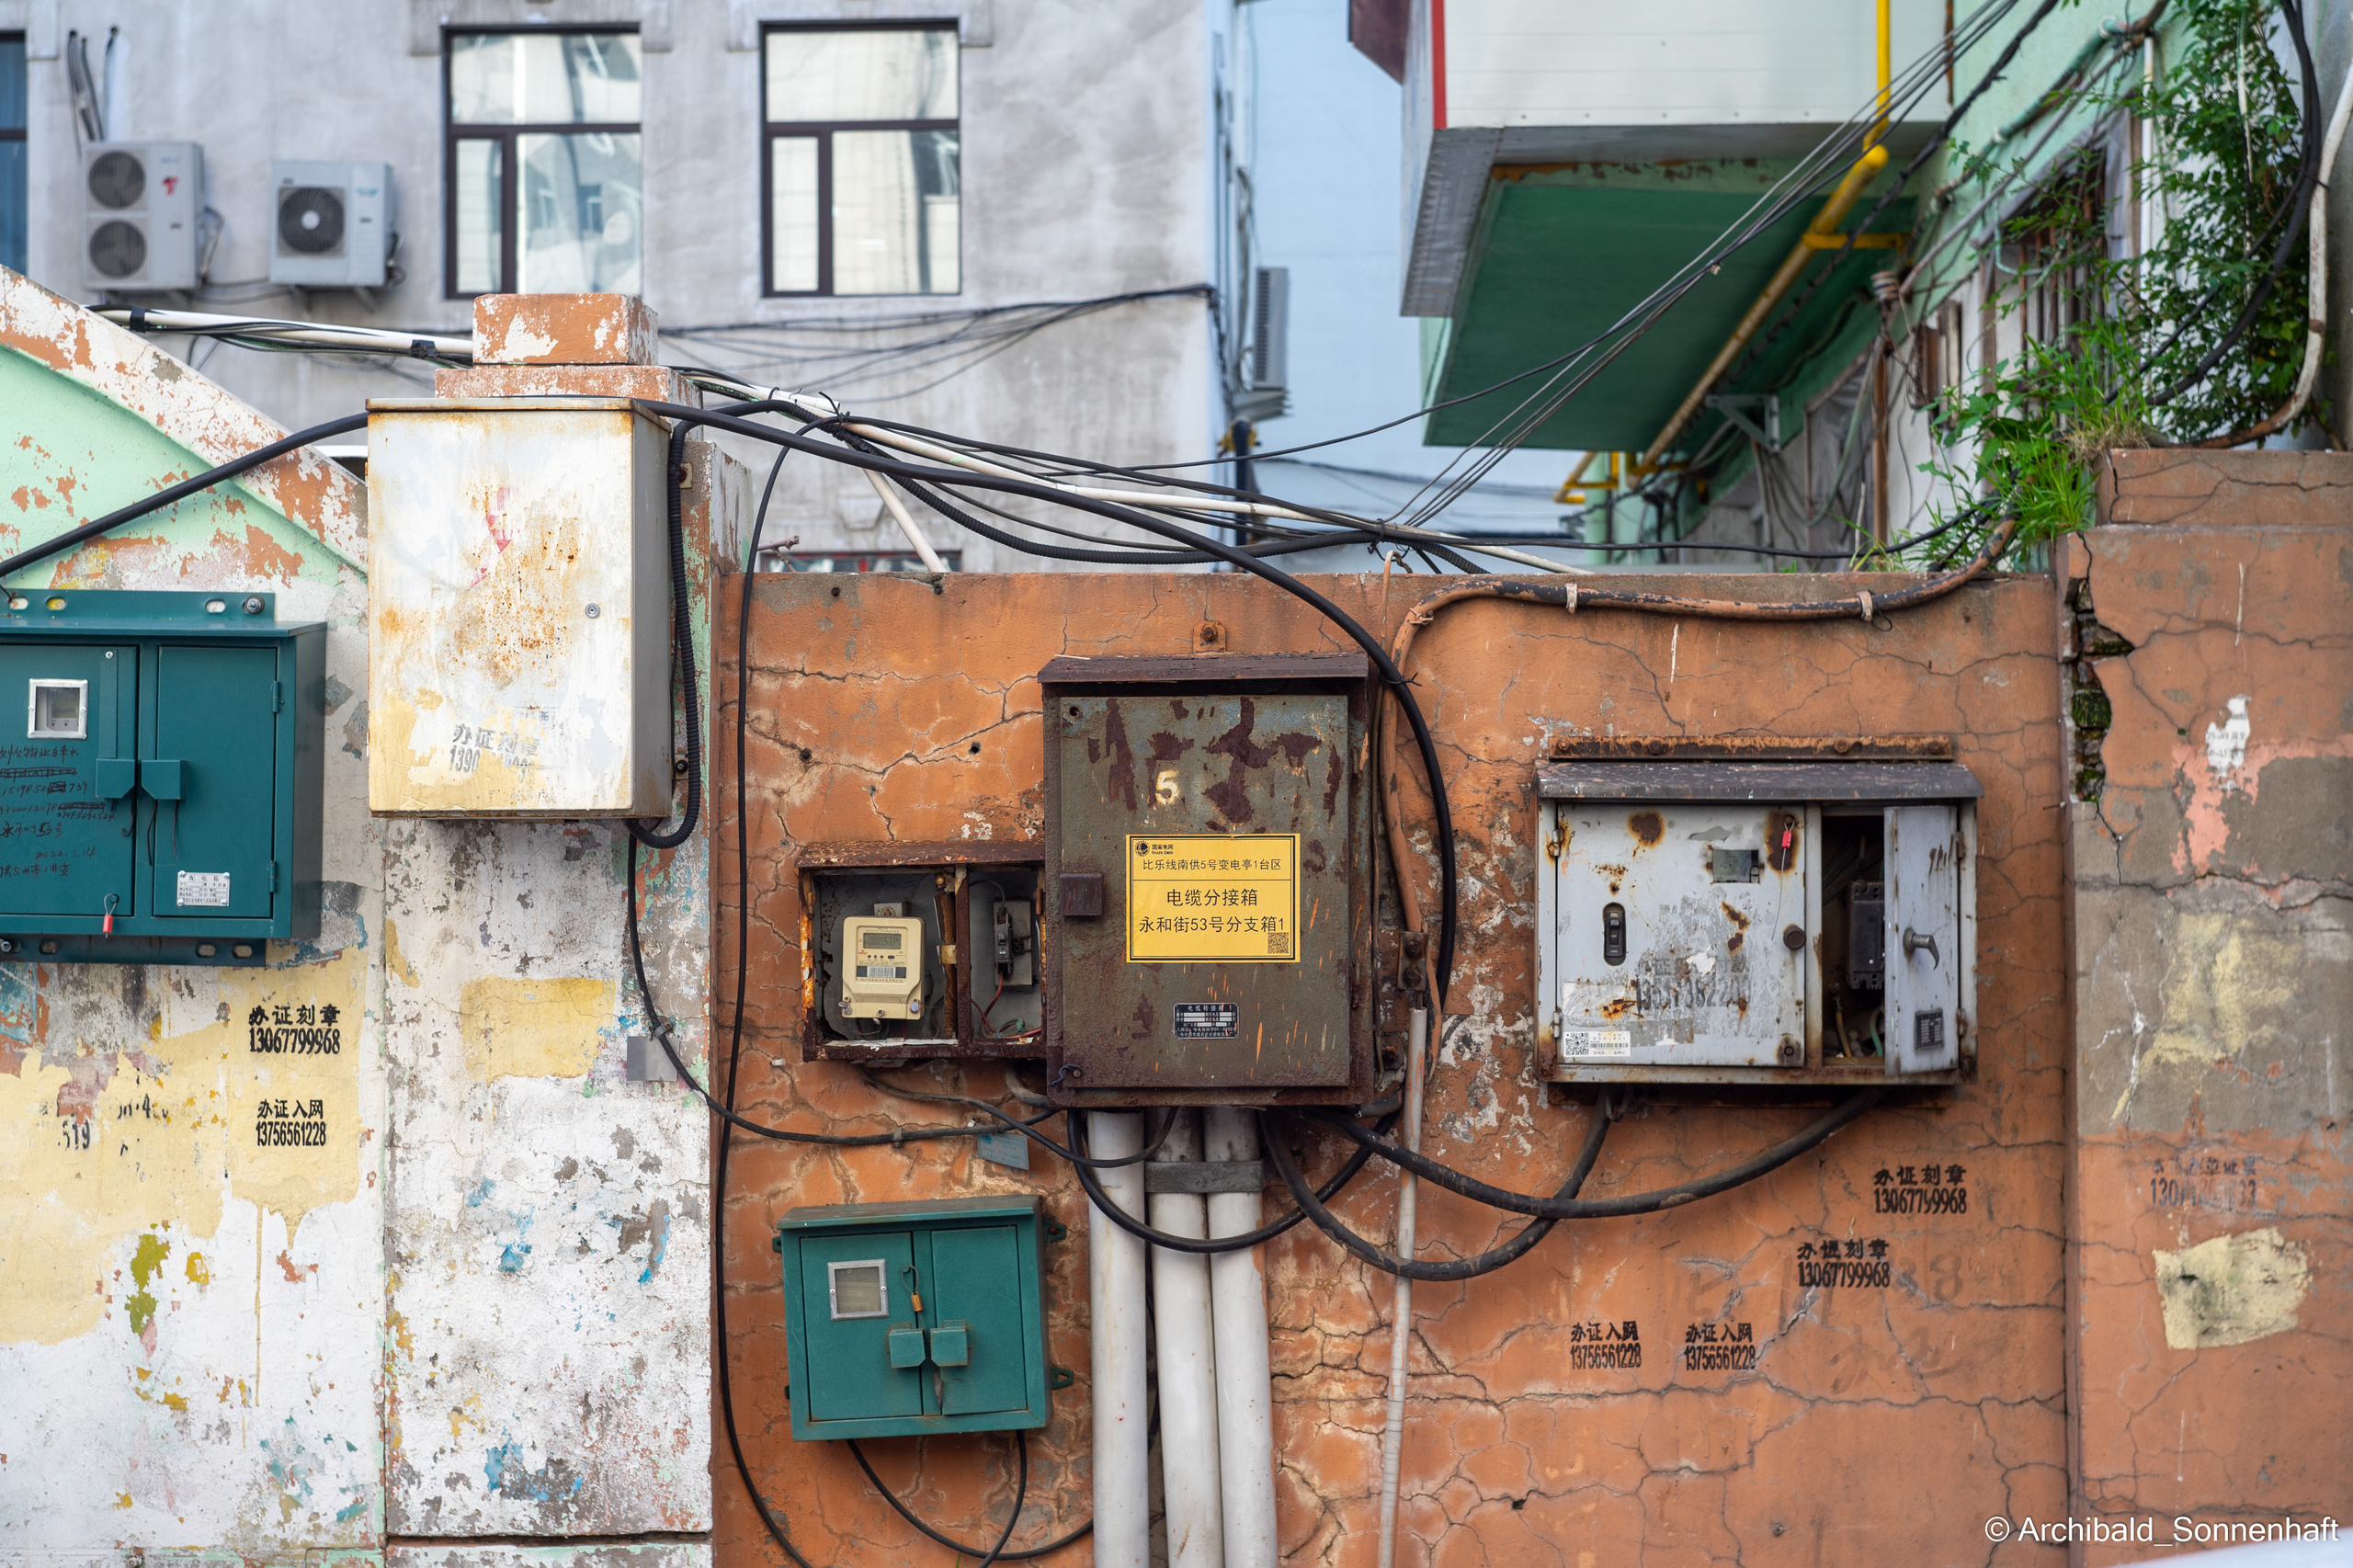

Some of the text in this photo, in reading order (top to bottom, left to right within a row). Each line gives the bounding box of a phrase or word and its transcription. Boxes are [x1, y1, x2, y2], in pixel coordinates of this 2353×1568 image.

[1154, 768, 1180, 805] 5
[1142, 858, 1282, 871] 比乐线南供5号变电亭1台区
[1166, 888, 1258, 907] 电缆分接箱
[1139, 915, 1285, 934] 永和街53号分支箱1
[248, 1004, 340, 1027] 办证刻章
[249, 1028, 340, 1054] 13067799968
[257, 1098, 324, 1119] 办证入网
[256, 1120, 326, 1146] 13756561228
[1873, 1164, 1967, 1187] 办证刻章
[1873, 1187, 1967, 1214] 13067799968
[1796, 1238, 1890, 1260] 办证刻章
[1798, 1261, 1890, 1288] 13067799968
[1570, 1321, 1639, 1343] 办证入网
[1685, 1323, 1753, 1343] 办证入网
[1570, 1342, 1642, 1369] 13756561228
[1684, 1345, 1756, 1370] 13756561228
